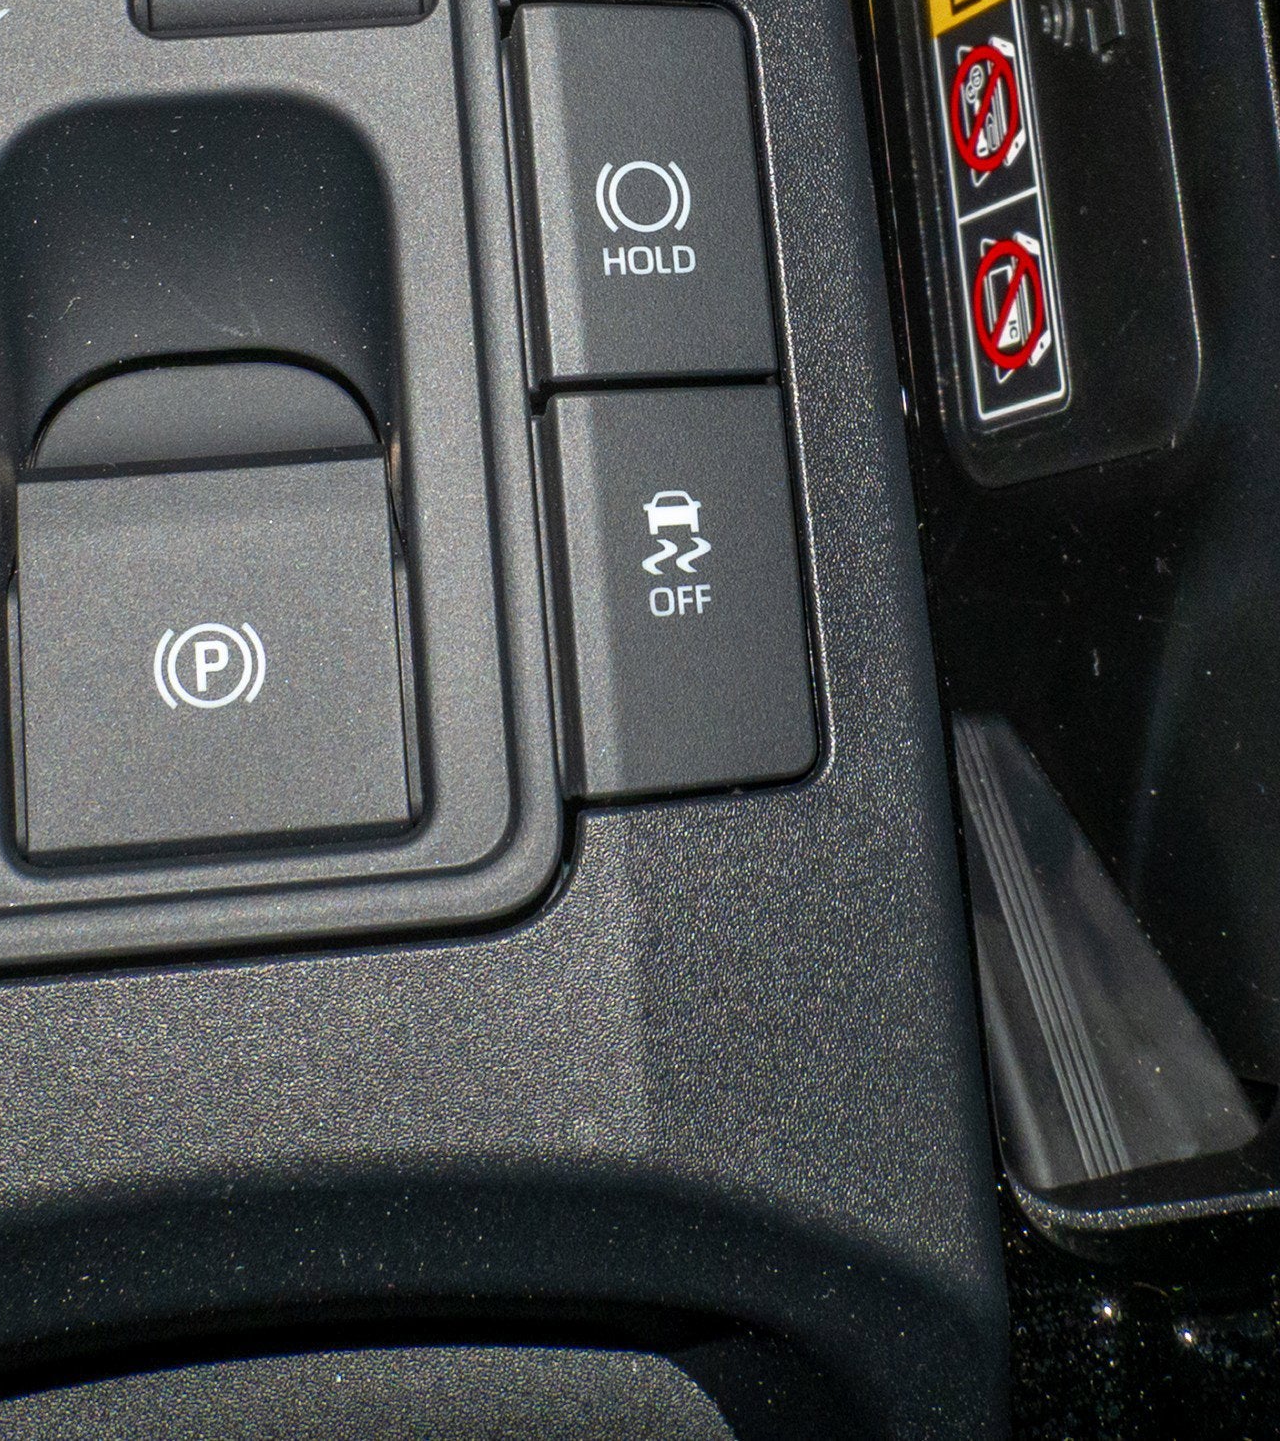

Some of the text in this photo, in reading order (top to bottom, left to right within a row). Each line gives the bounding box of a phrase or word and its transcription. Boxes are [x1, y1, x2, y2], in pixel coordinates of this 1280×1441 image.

[602, 245, 696, 276] HOLD
[649, 584, 711, 617] OFF
[194, 640, 229, 691] P
